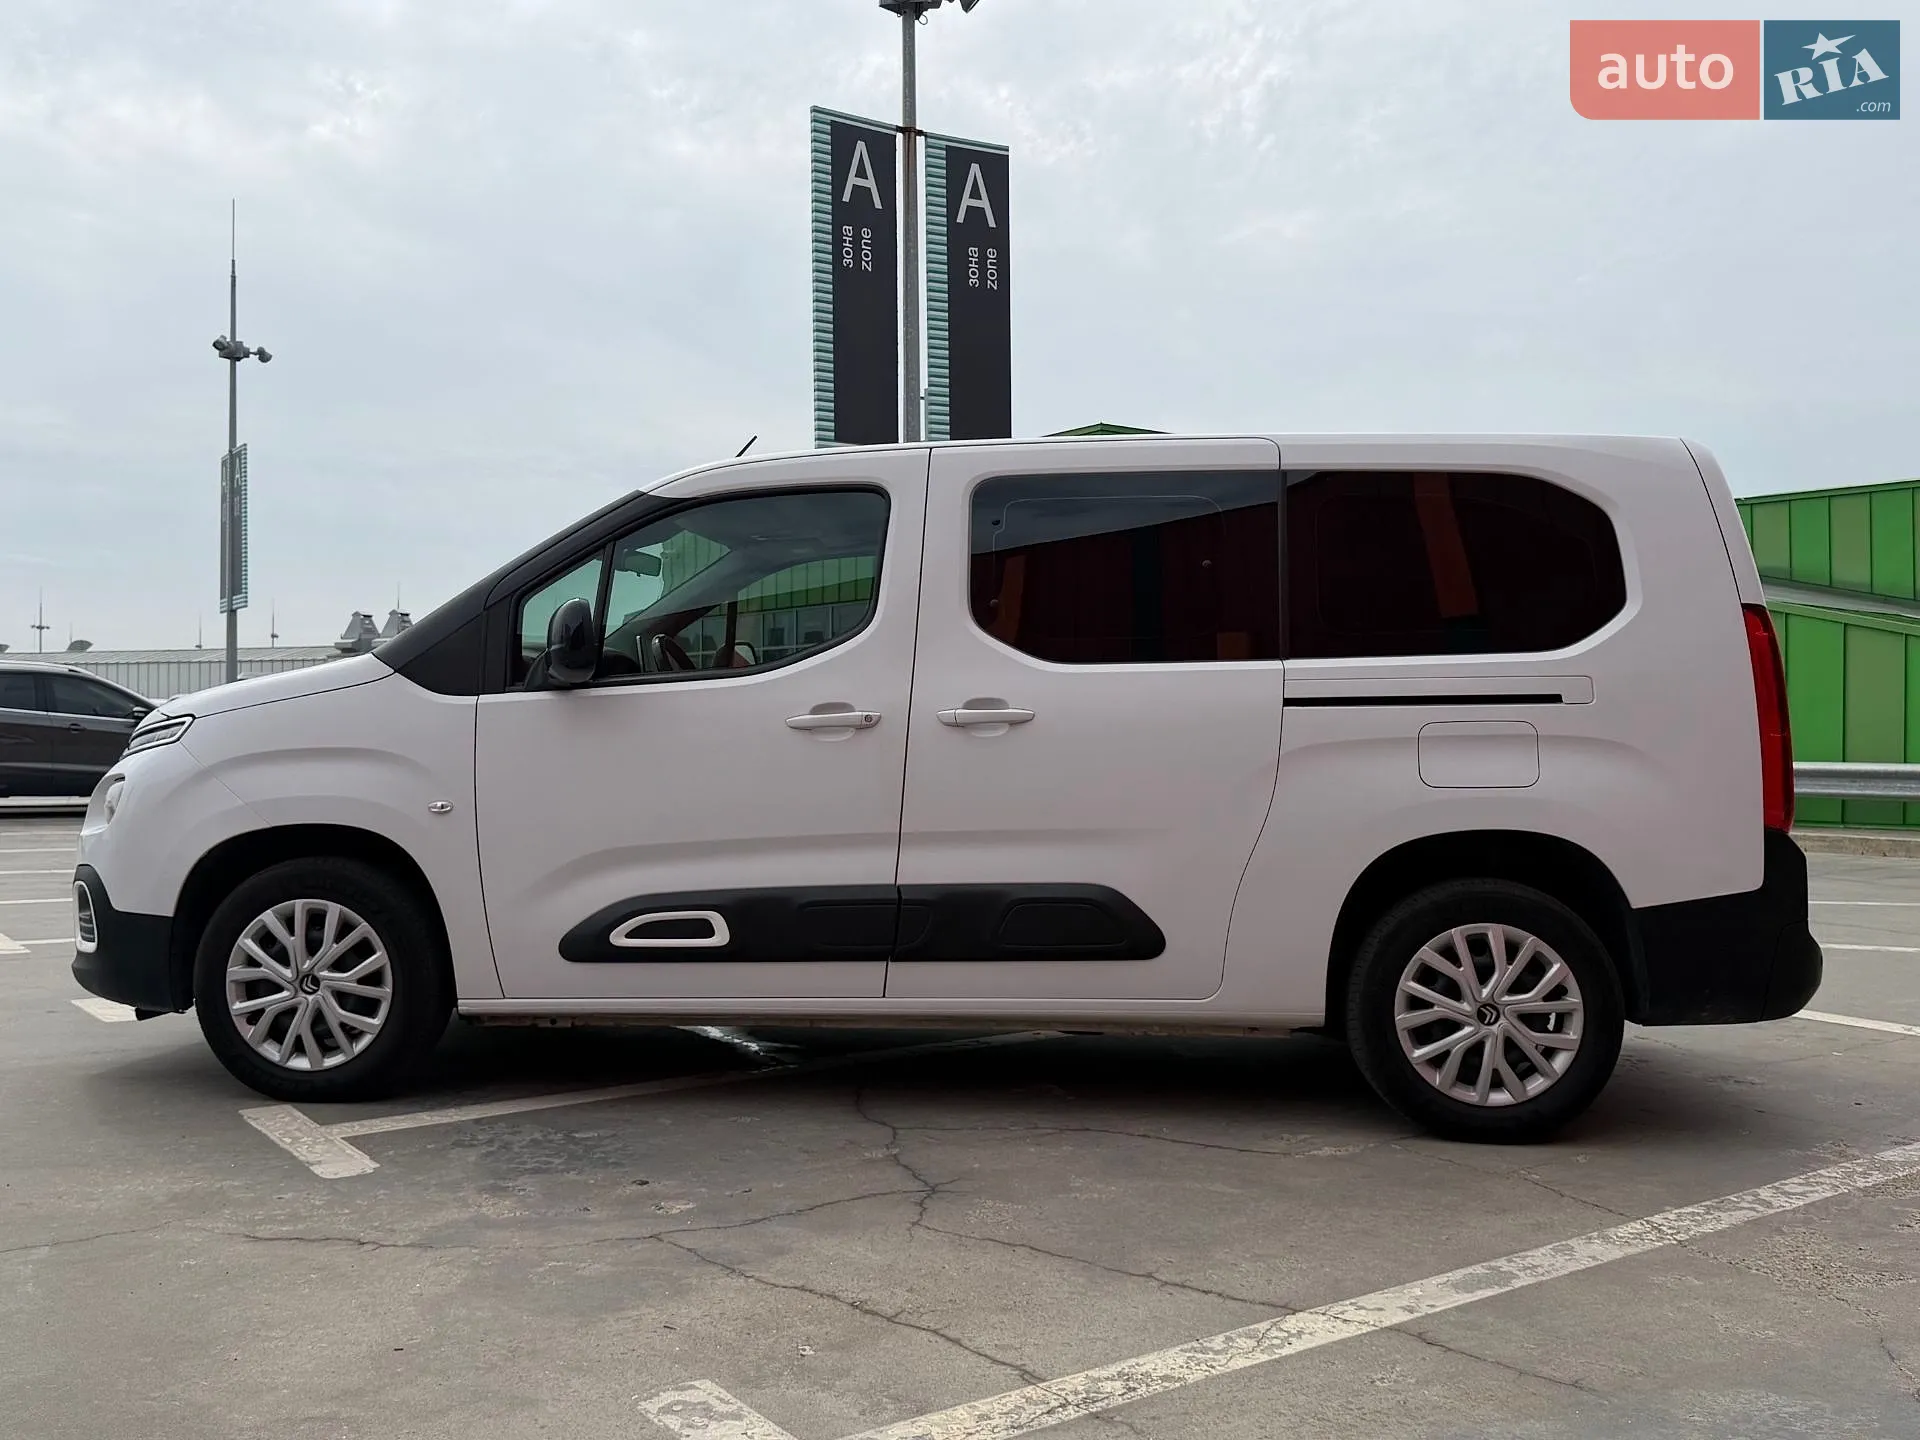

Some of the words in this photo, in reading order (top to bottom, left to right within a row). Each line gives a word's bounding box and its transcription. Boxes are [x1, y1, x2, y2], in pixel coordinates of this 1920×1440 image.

[841, 140, 883, 209] A
[956, 162, 997, 228] A
[842, 225, 853, 268] зона
[861, 227, 872, 271] zone
[968, 246, 979, 288] зона
[986, 248, 998, 290] zone
